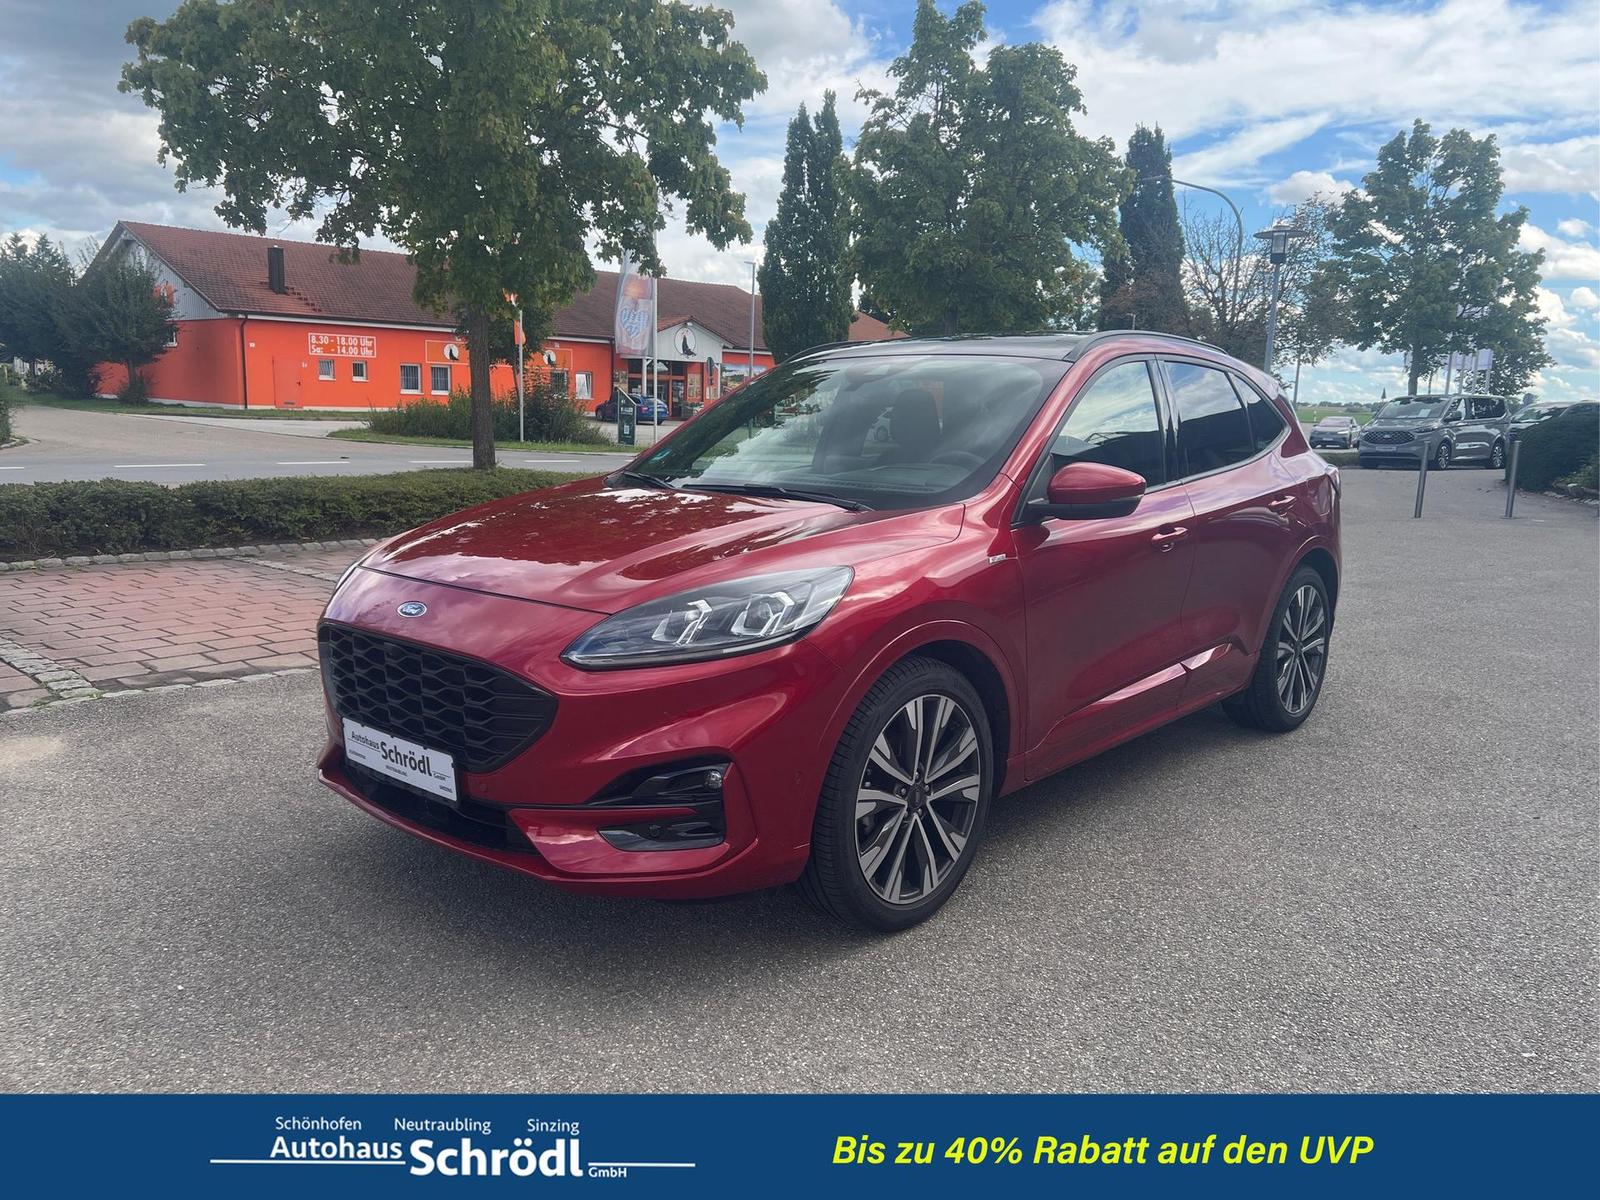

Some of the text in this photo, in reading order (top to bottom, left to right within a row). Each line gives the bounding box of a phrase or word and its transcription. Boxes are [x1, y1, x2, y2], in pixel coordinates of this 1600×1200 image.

[311, 335, 329, 344] 8.30
[336, 336, 358, 346] 18.00
[360, 337, 373, 347] Uhr
[336, 346, 358, 355] 14.00
[360, 346, 373, 356] Uhr
[351, 731, 380, 750] Autohaus
[380, 741, 432, 777] Schrödl
